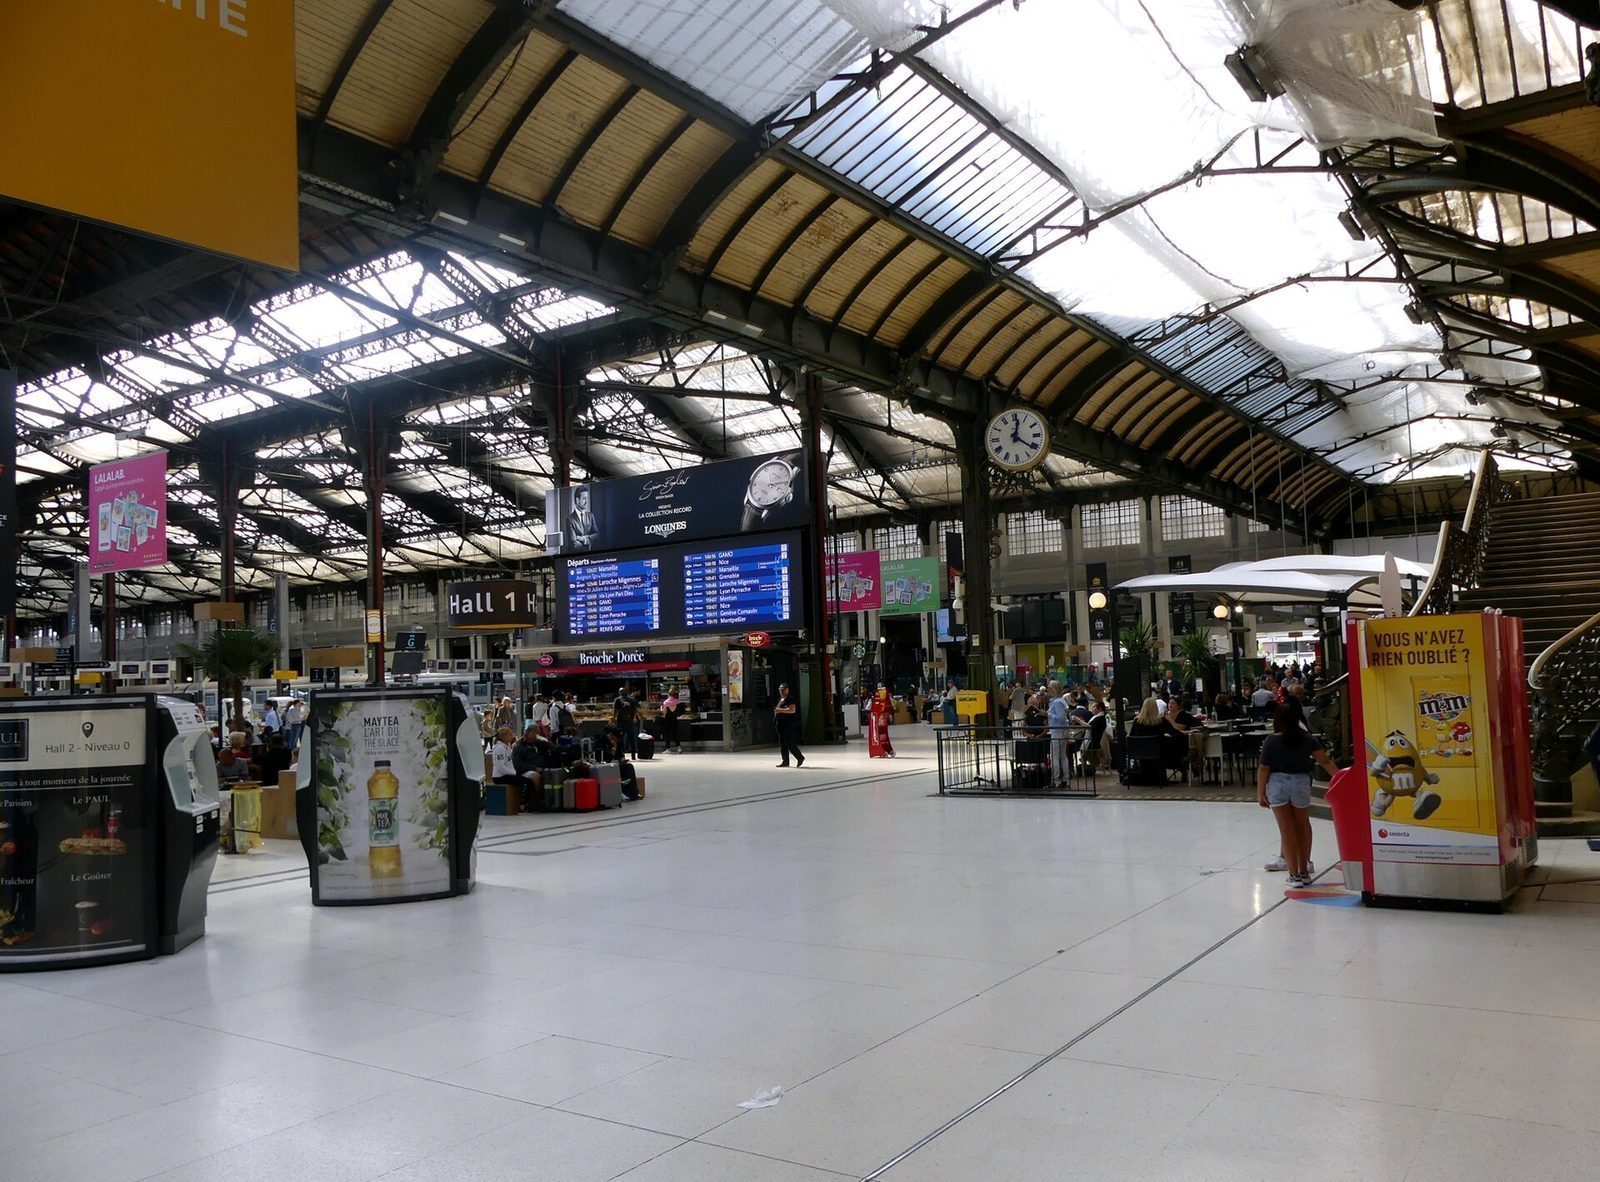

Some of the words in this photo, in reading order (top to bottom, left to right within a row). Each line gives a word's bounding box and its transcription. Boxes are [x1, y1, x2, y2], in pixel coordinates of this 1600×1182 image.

[645, 509, 673, 518] COLLECTION
[674, 506, 692, 514] RECORD
[644, 520, 687, 534] LONGINES
[567, 558, 590, 568] Départs
[618, 576, 641, 585] Migennes
[738, 578, 759, 586] Migennes
[450, 592, 494, 615] Hall
[504, 592, 516, 612] 1
[408, 638, 415, 646] G
[1374, 632, 1410, 648] VOUS
[1414, 629, 1465, 646] N'AVEZ
[580, 652, 614, 665] Brioche
[617, 650, 644, 662] Dorée
[1372, 651, 1403, 667] RIEN
[1407, 645, 1458, 665] OUBLIÉ
[1462, 648, 1470, 663] ?
[364, 716, 400, 727] MAYTEA
[0, 732, 22, 744] UL
[364, 727, 384, 738] L'ART
[388, 726, 400, 736] DU
[46, 744, 65, 754] Hall
[69, 744, 75, 752] 2
[85, 742, 120, 753] Niveau
[124, 742, 130, 751] 0
[20, 778, 24, 786] à
[25, 778, 40, 786] tout
[43, 776, 76, 786] moment
[78, 775, 88, 784] de
[91, 775, 98, 783] la
[100, 774, 131, 785] journée
[4, 798, 32, 808] Parisien
[73, 796, 82, 804] Le
[86, 795, 110, 804] PAUL
[1, 876, 35, 885] Fraîcheur
[72, 874, 82, 882] Le
[83, 872, 112, 880] Goûter
